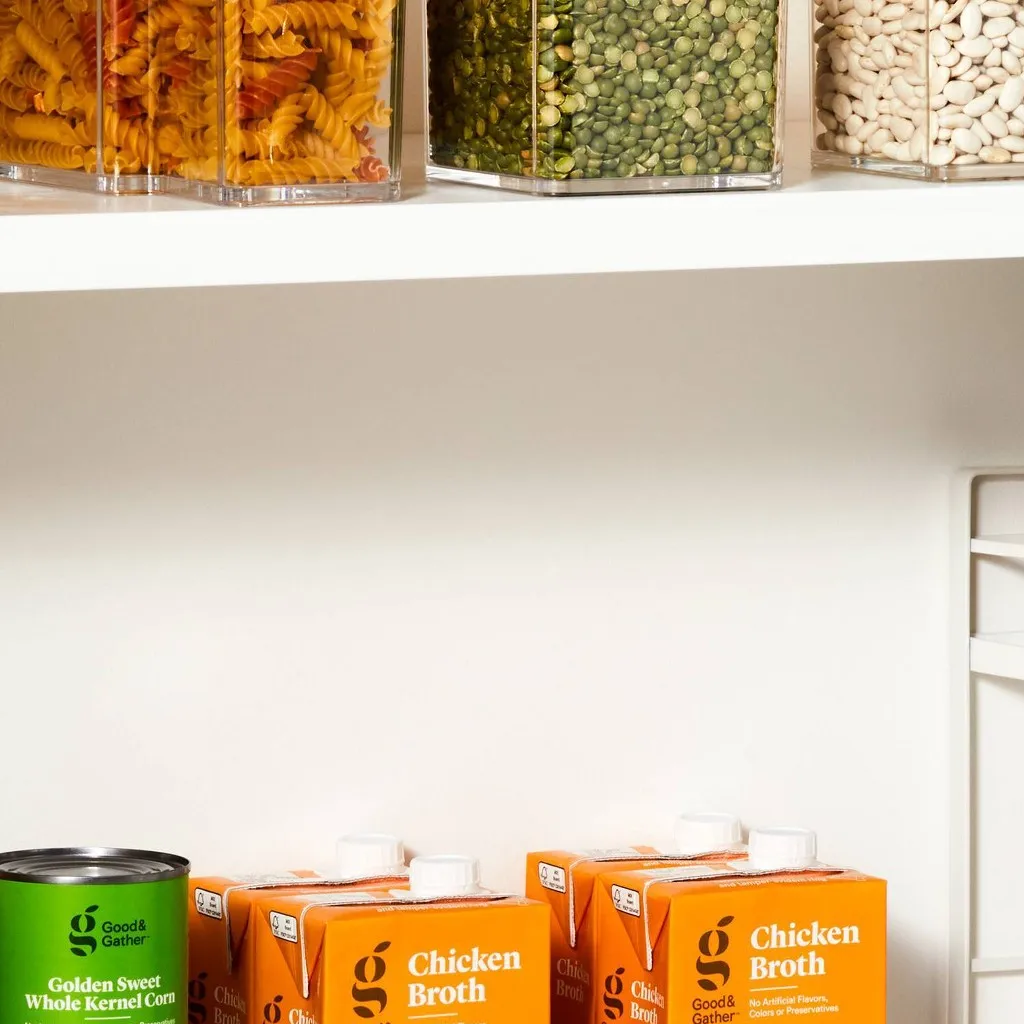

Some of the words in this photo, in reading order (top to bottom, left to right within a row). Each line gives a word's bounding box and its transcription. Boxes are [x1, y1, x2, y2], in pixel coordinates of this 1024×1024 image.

[101, 919, 147, 933] Good&
[750, 921, 860, 950] Chicken
[101, 934, 146, 947] Gather
[407, 946, 521, 977] Chicken
[750, 951, 826, 980] Broth
[48, 976, 114, 993] Golden
[117, 975, 161, 992] Sweet
[407, 976, 486, 1008] Broth
[556, 979, 584, 1005] Broth
[24, 994, 81, 1011] Whole
[84, 993, 142, 1011] Kernel
[144, 991, 175, 1007] Corn
[631, 980, 665, 1009] Chicken
[692, 994, 735, 1011] Good&
[749, 998, 761, 1007] No
[762, 995, 796, 1006] Artificial
[797, 993, 828, 1004] Flavors,
[749, 1009, 774, 1019] Colors
[776, 1008, 784, 1016] or
[786, 1003, 839, 1015] Preservatives
